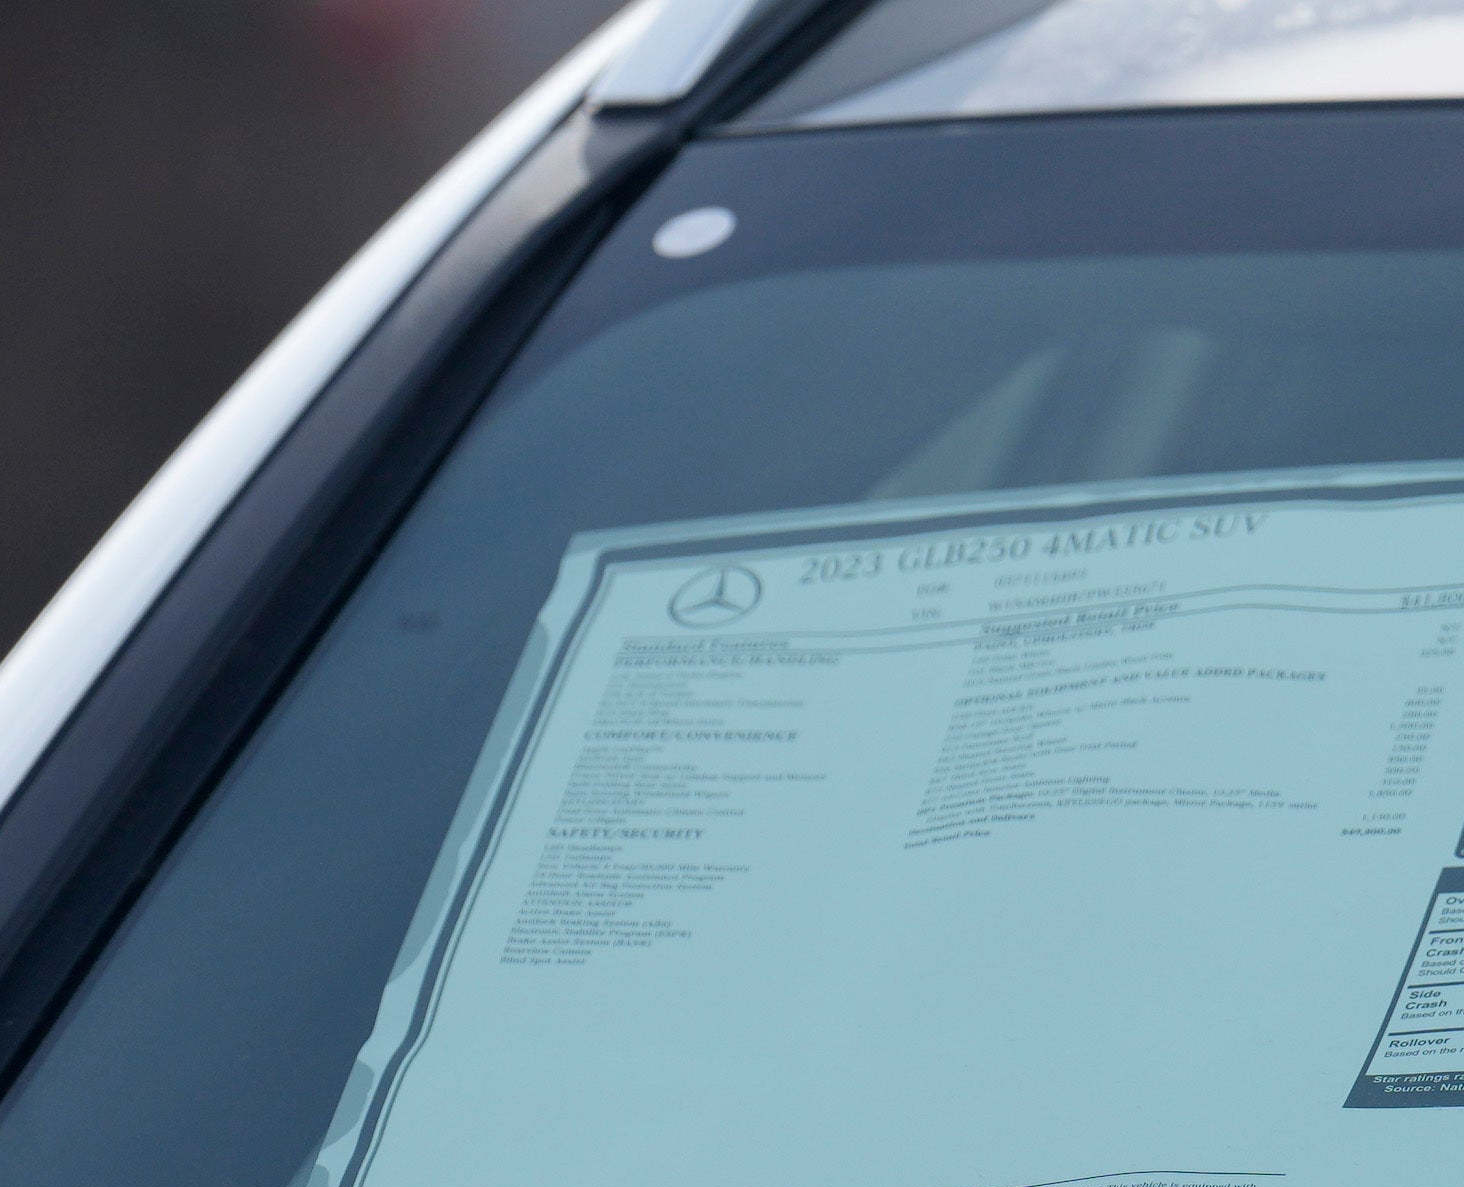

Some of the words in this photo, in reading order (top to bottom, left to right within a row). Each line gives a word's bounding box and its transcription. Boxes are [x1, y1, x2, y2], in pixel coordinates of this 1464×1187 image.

[798, 551, 884, 585] 2023
[1041, 519, 1183, 557] 4MATIC
[1190, 513, 1270, 541] SUV
[1409, 989, 1442, 1000] Side
[1405, 999, 1448, 1011] Crash
[1388, 1036, 1452, 1049] Rollover
[1373, 1074, 1401, 1086] Star
[1403, 1073, 1450, 1085] ratings
[1384, 1085, 1437, 1094] Source:
